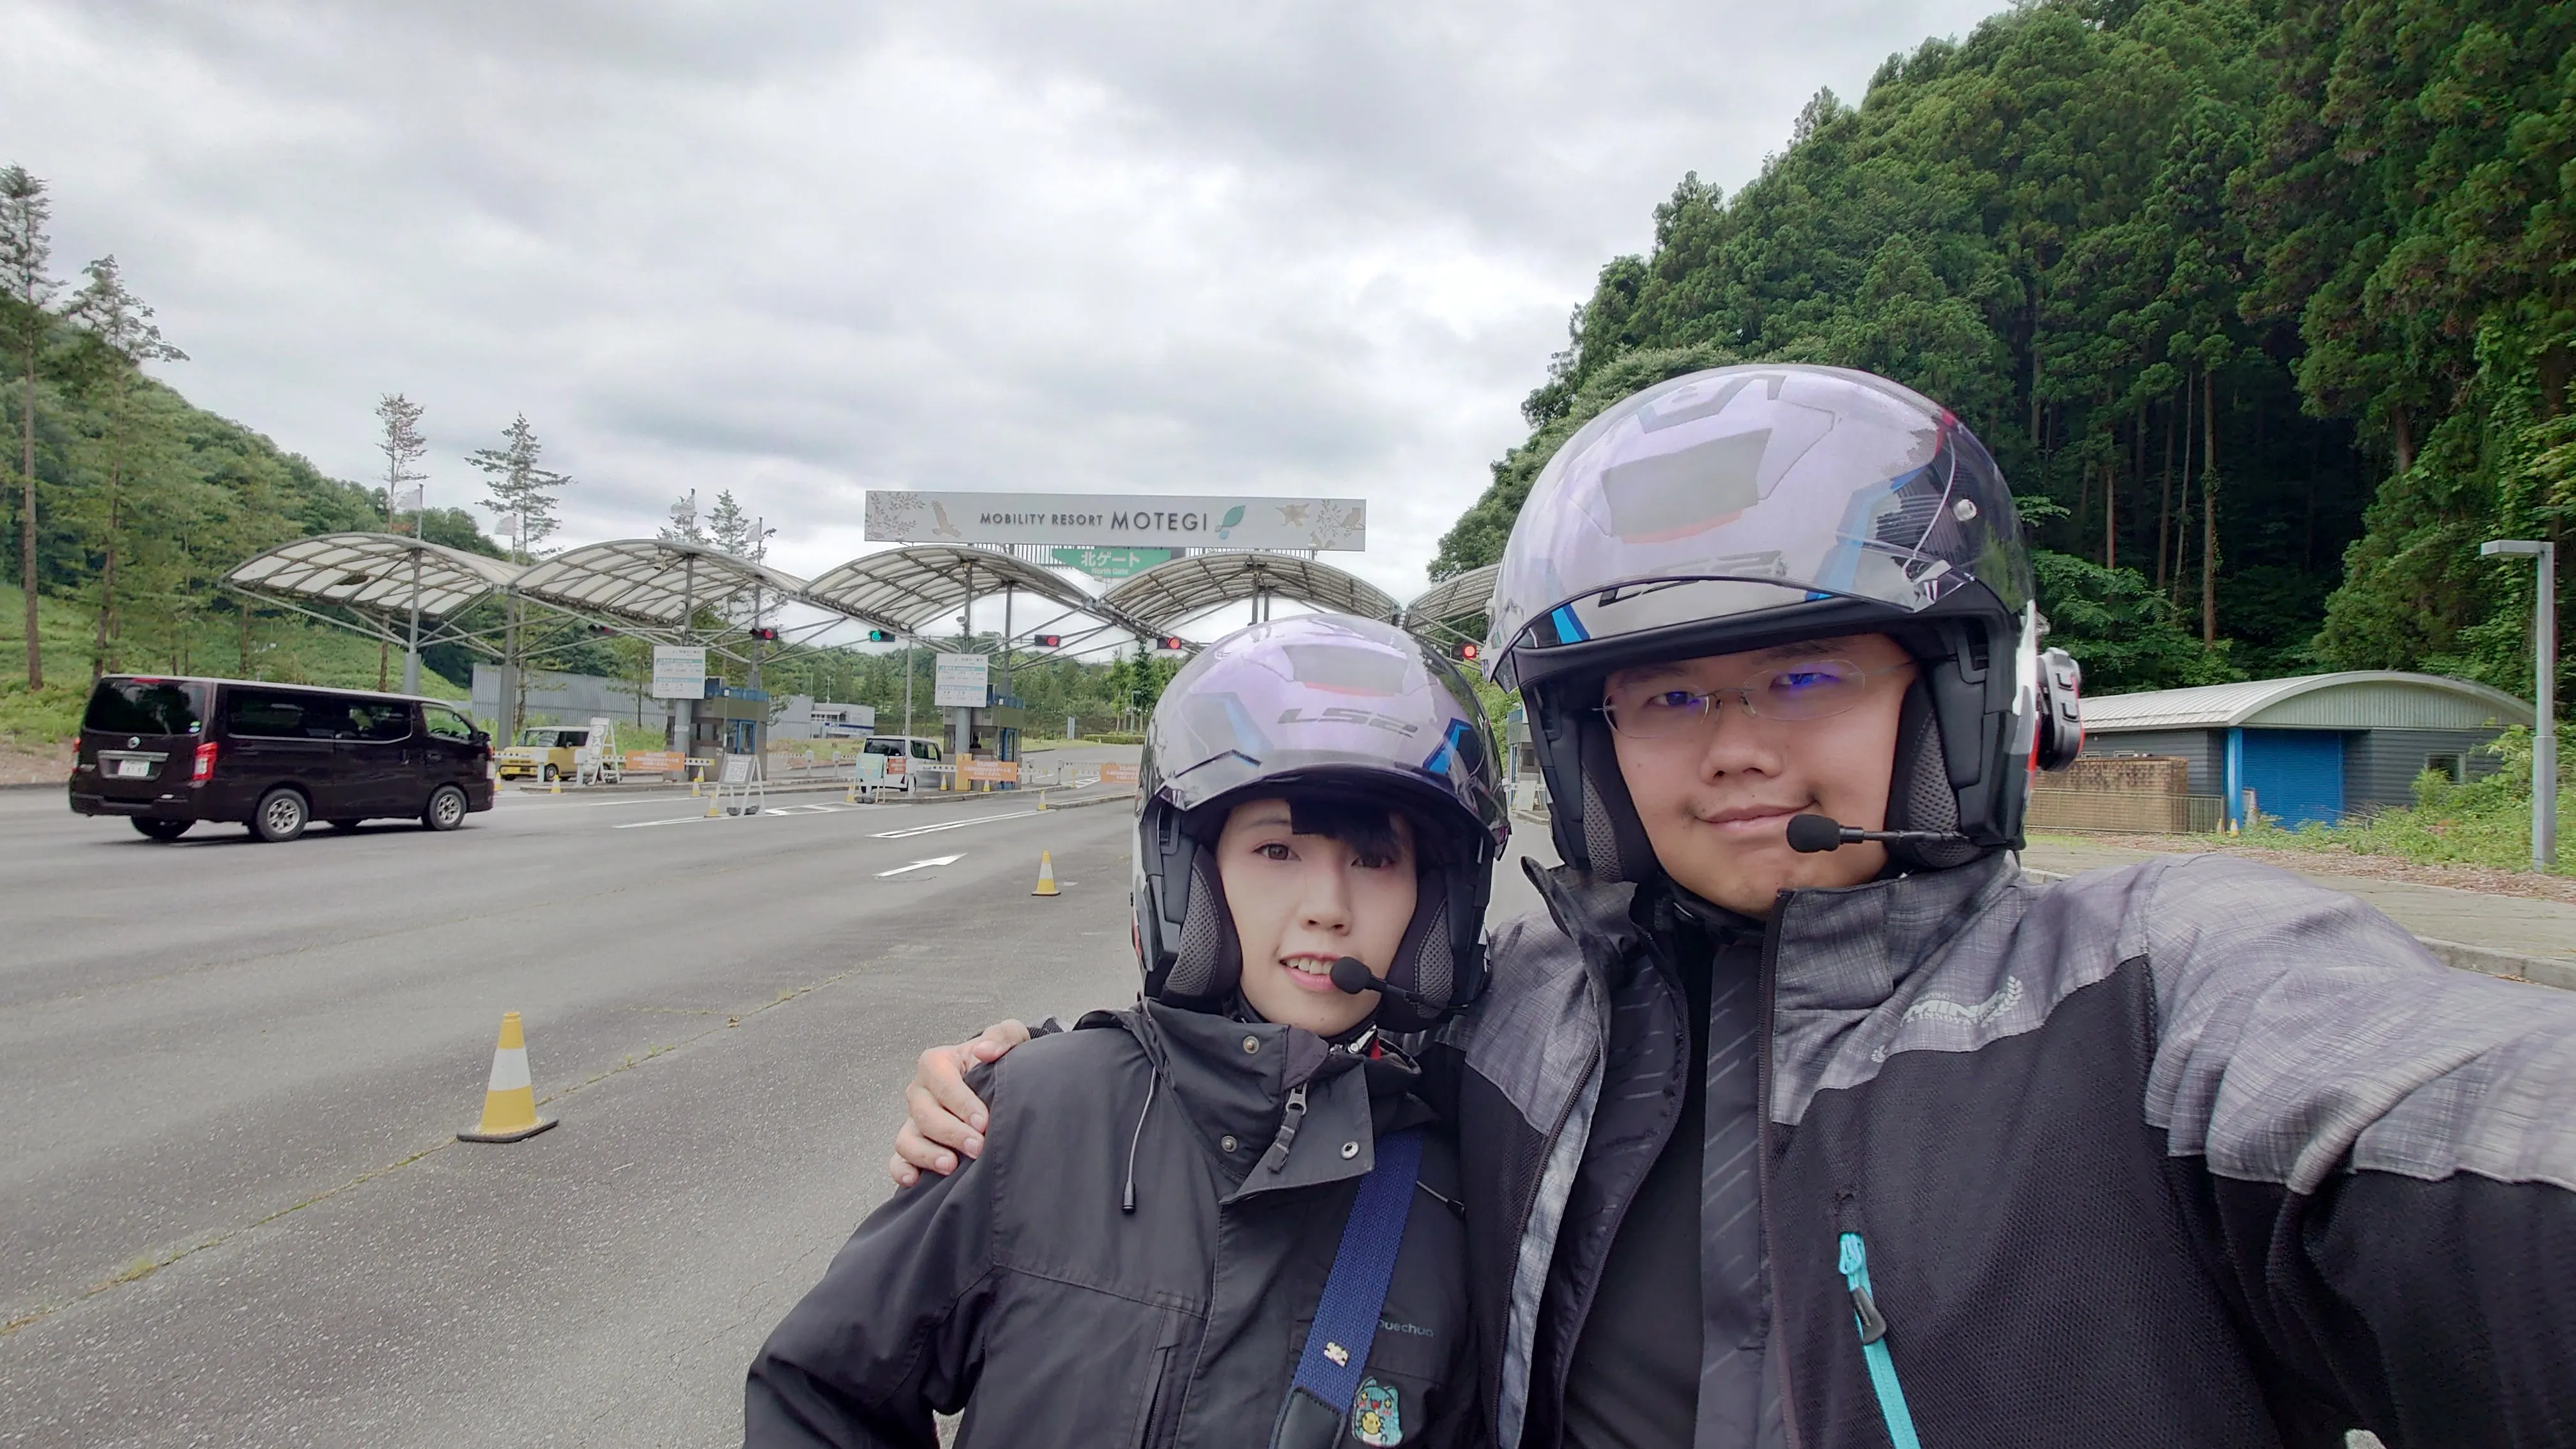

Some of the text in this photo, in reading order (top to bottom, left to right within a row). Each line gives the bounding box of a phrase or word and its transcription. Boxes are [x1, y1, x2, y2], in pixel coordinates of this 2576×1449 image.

[980, 510, 1208, 531] MOBILITY RESORT MOTEGI
[1080, 551, 1141, 567] 北ゲート
